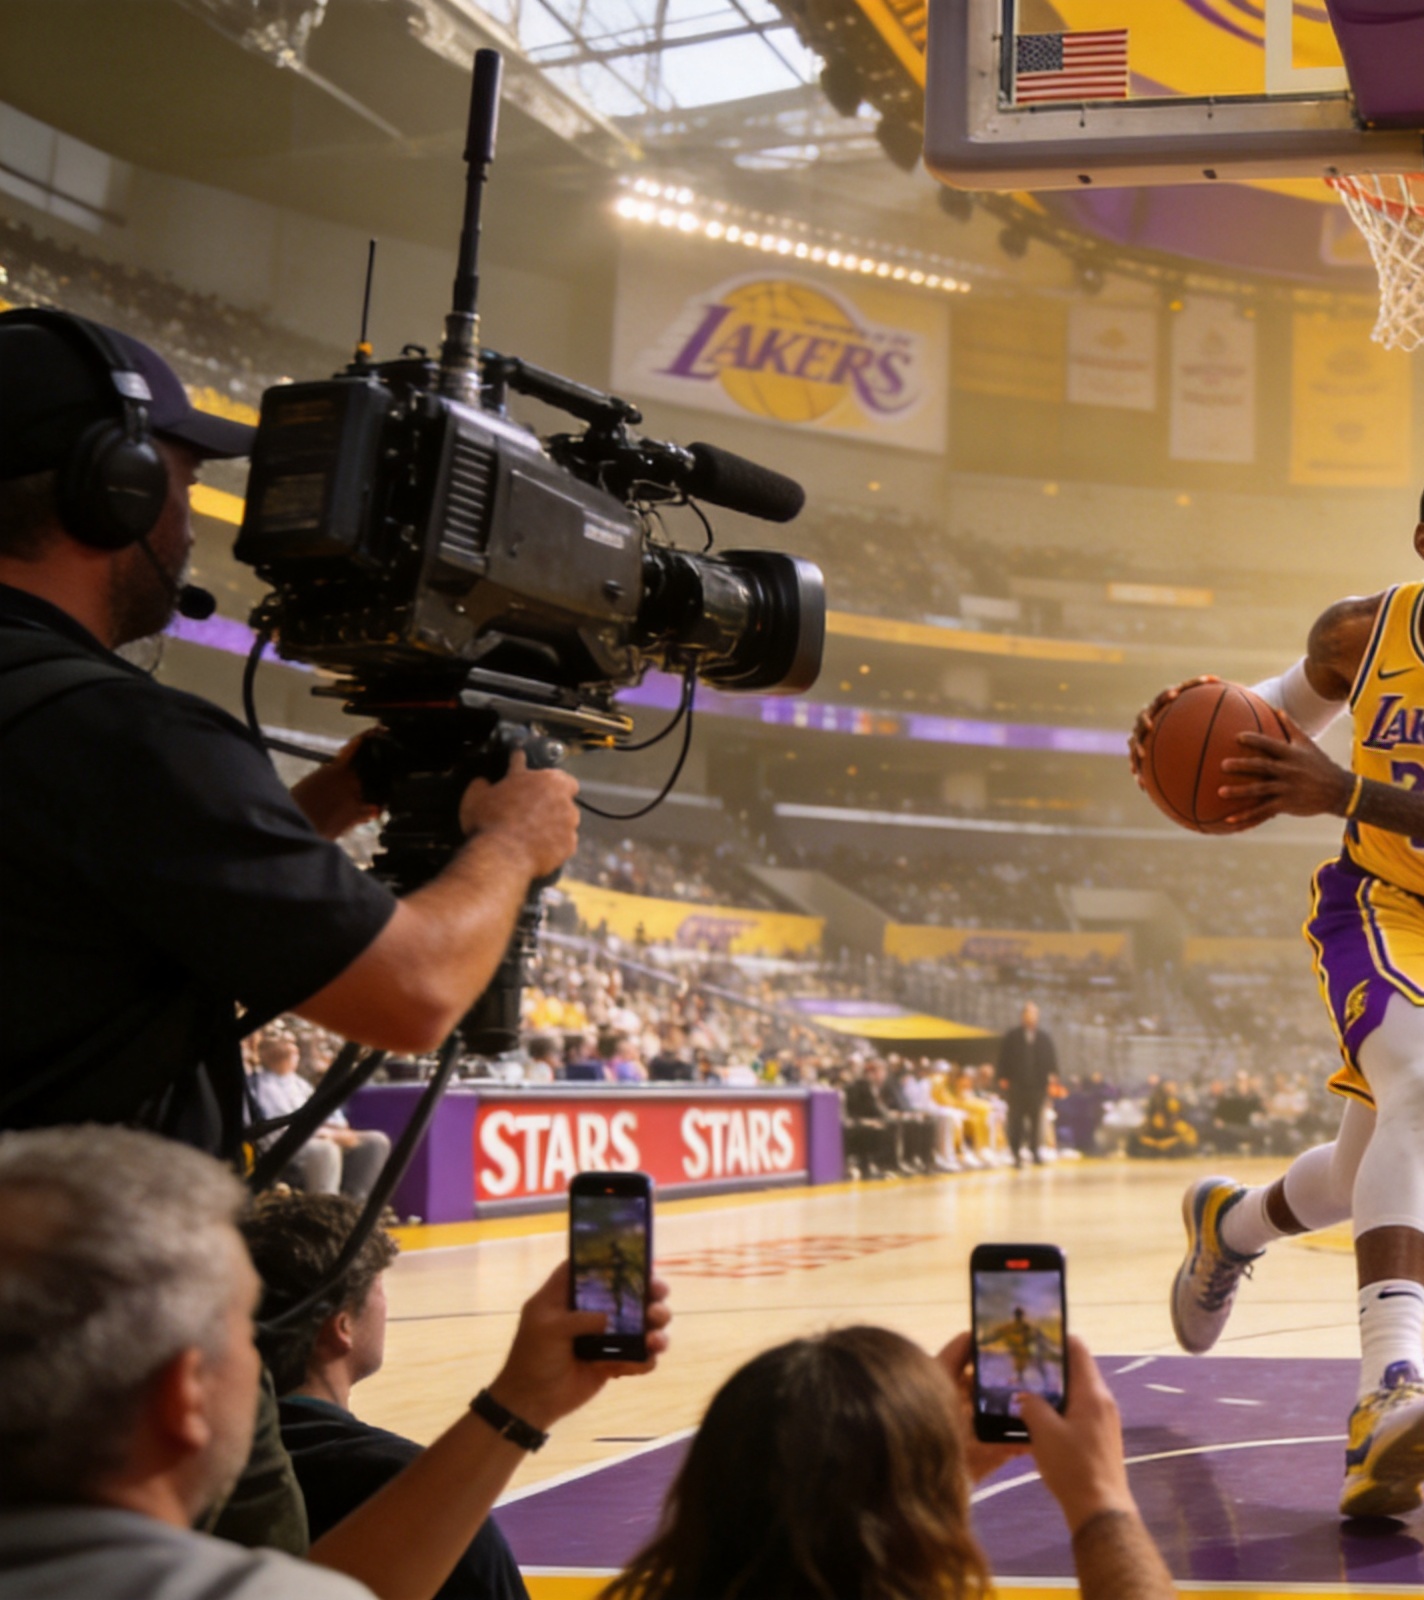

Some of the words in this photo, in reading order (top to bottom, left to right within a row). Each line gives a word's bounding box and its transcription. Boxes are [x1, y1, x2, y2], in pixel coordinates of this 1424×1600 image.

[651, 303, 918, 413] LAKERS
[479, 1109, 641, 1196] STARS
[680, 1107, 795, 1179] STARS
